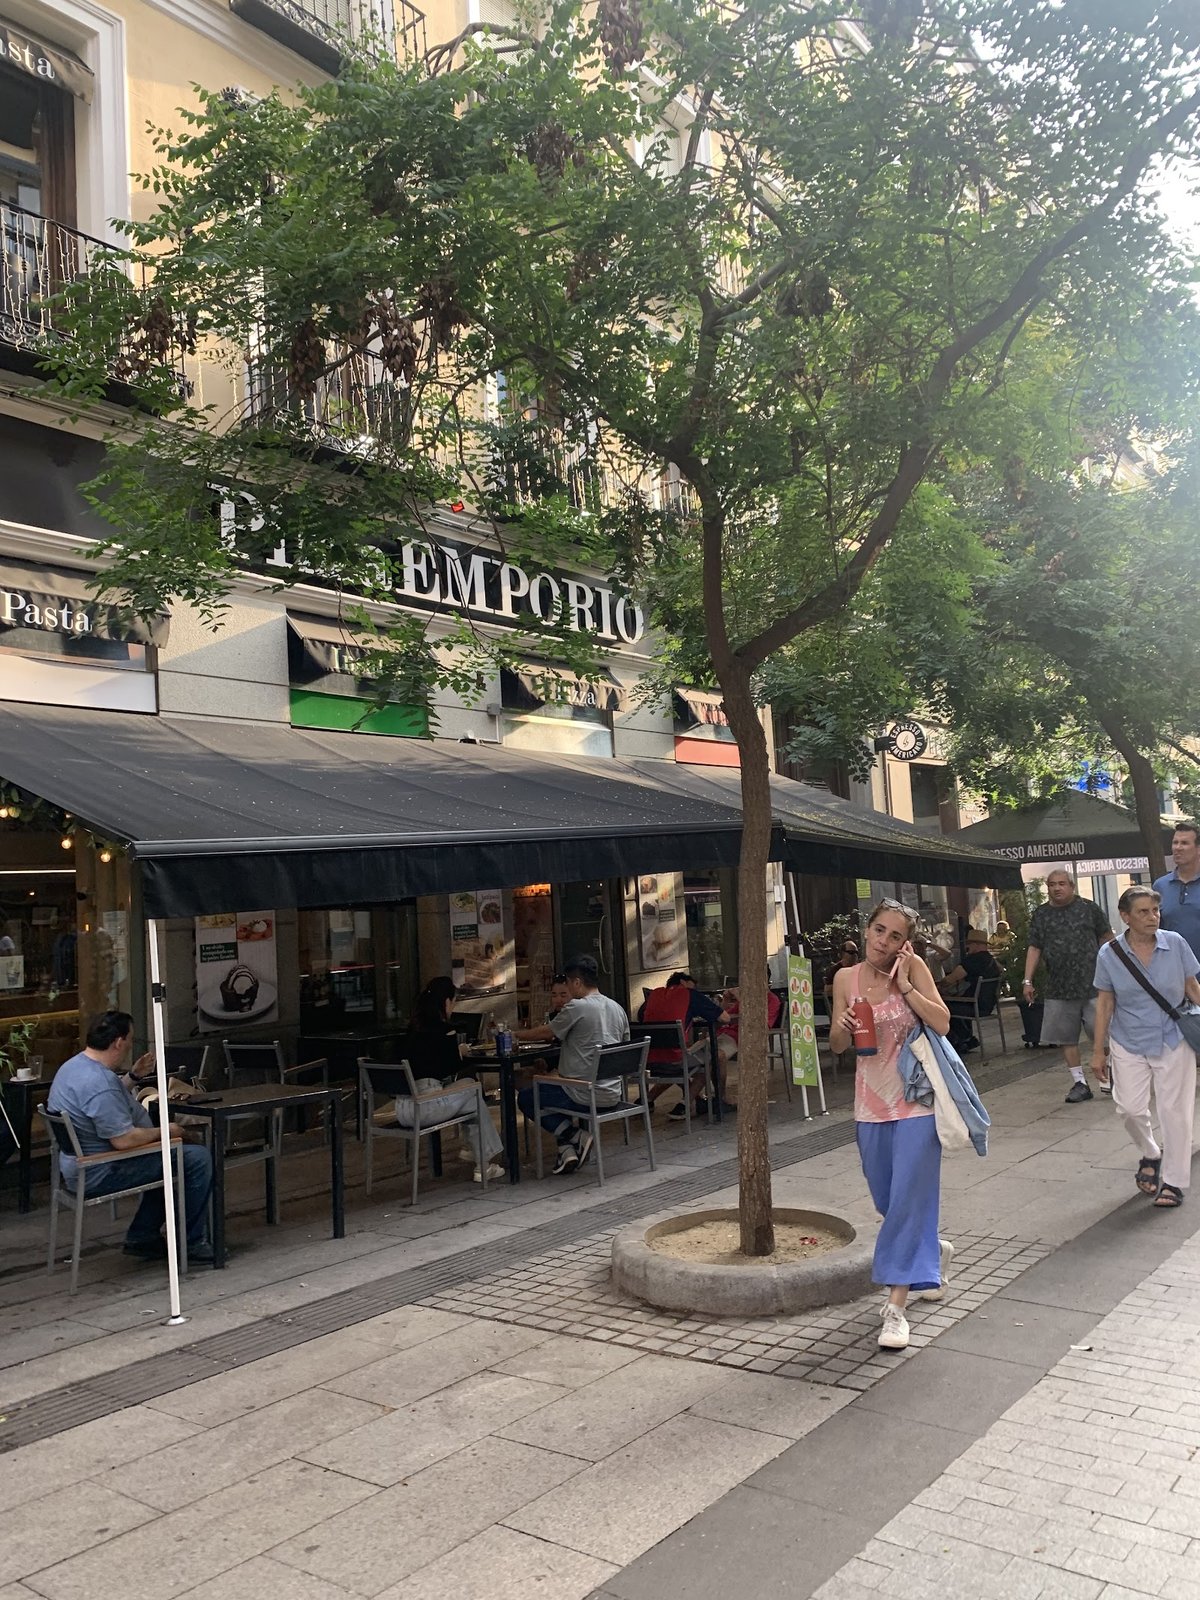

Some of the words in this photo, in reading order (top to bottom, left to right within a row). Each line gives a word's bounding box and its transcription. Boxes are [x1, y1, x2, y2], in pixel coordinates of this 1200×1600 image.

[396, 536, 645, 644] EMPORIO
[0, 590, 93, 633] Pasta
[890, 723, 921, 738] ESPRESSO
[890, 741, 923, 759] AMERICANO
[1027, 841, 1085, 858] AMERICANO
